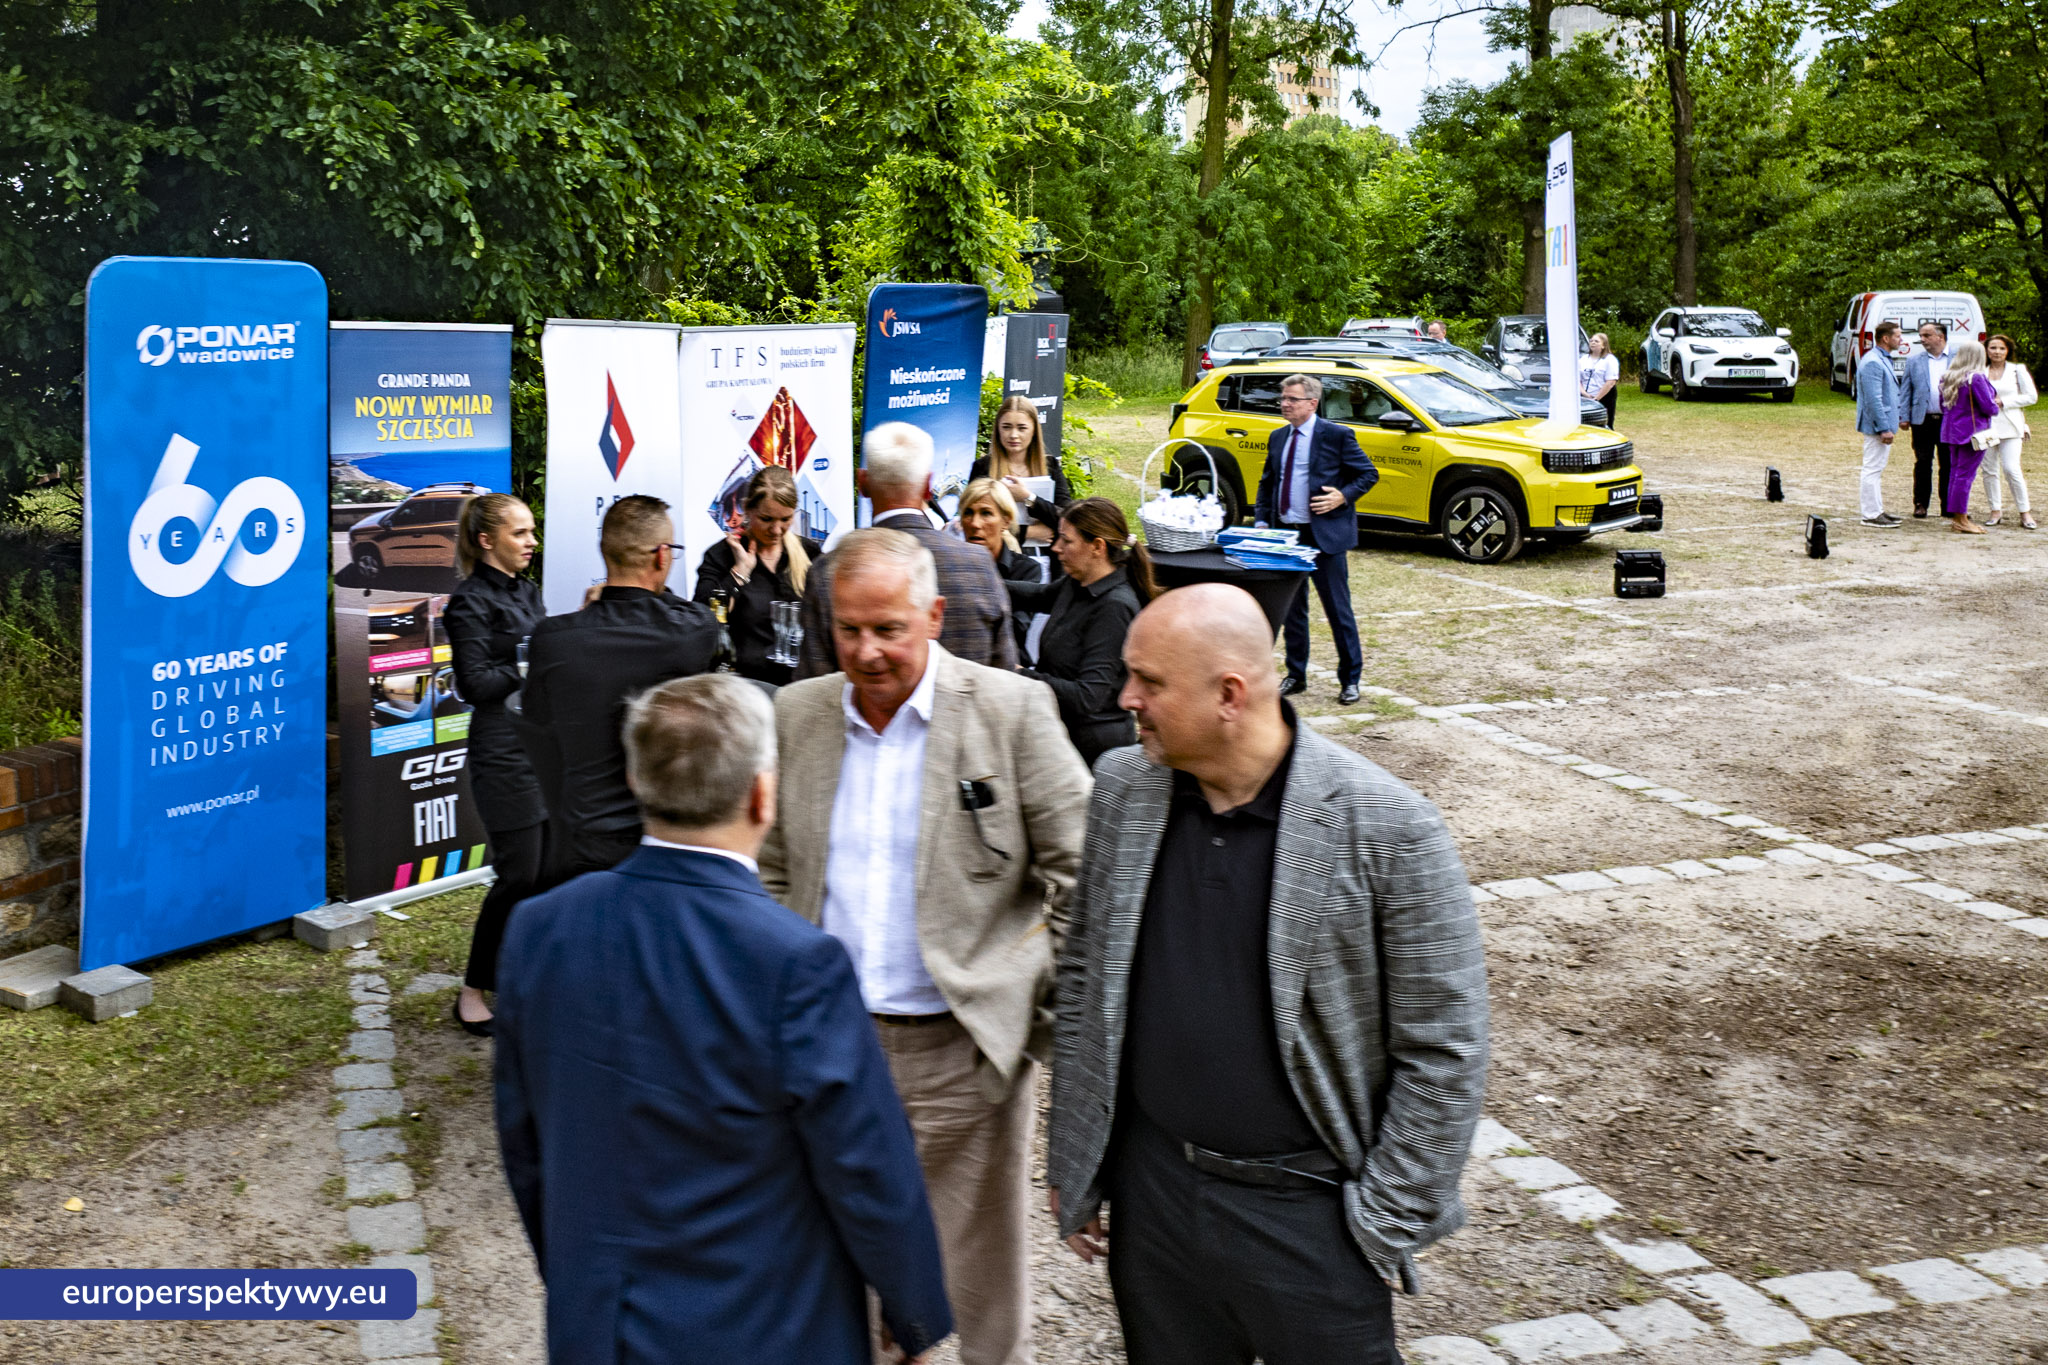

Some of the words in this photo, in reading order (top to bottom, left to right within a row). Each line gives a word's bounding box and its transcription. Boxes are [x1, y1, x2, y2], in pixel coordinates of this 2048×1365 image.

[176, 323, 295, 348] PONAR
[177, 346, 295, 364] wadowice
[810, 358, 825, 368] firm
[378, 374, 429, 388] GRANDE
[431, 373, 472, 388] PANDA
[890, 366, 966, 385] Nieskończone
[355, 395, 417, 417] NOWY
[420, 394, 493, 416] WYMIAR
[888, 387, 951, 409] możliwości
[377, 414, 474, 442] SZCZĘŚCIA
[1238, 440, 1269, 451] GRAND
[1367, 455, 1386, 465] AZDĘ
[1388, 456, 1422, 468] TESTOWĄ
[152, 661, 182, 682] 60
[185, 648, 255, 676] YEARS
[259, 642, 288, 663] OF
[151, 669, 285, 711] DRIVING
[151, 697, 286, 737] GLOBAL
[150, 722, 285, 767] INDUSTRY
[401, 747, 469, 781] GG
[166, 785, 260, 818] www.ponar.pl
[413, 793, 459, 847] FIAT
